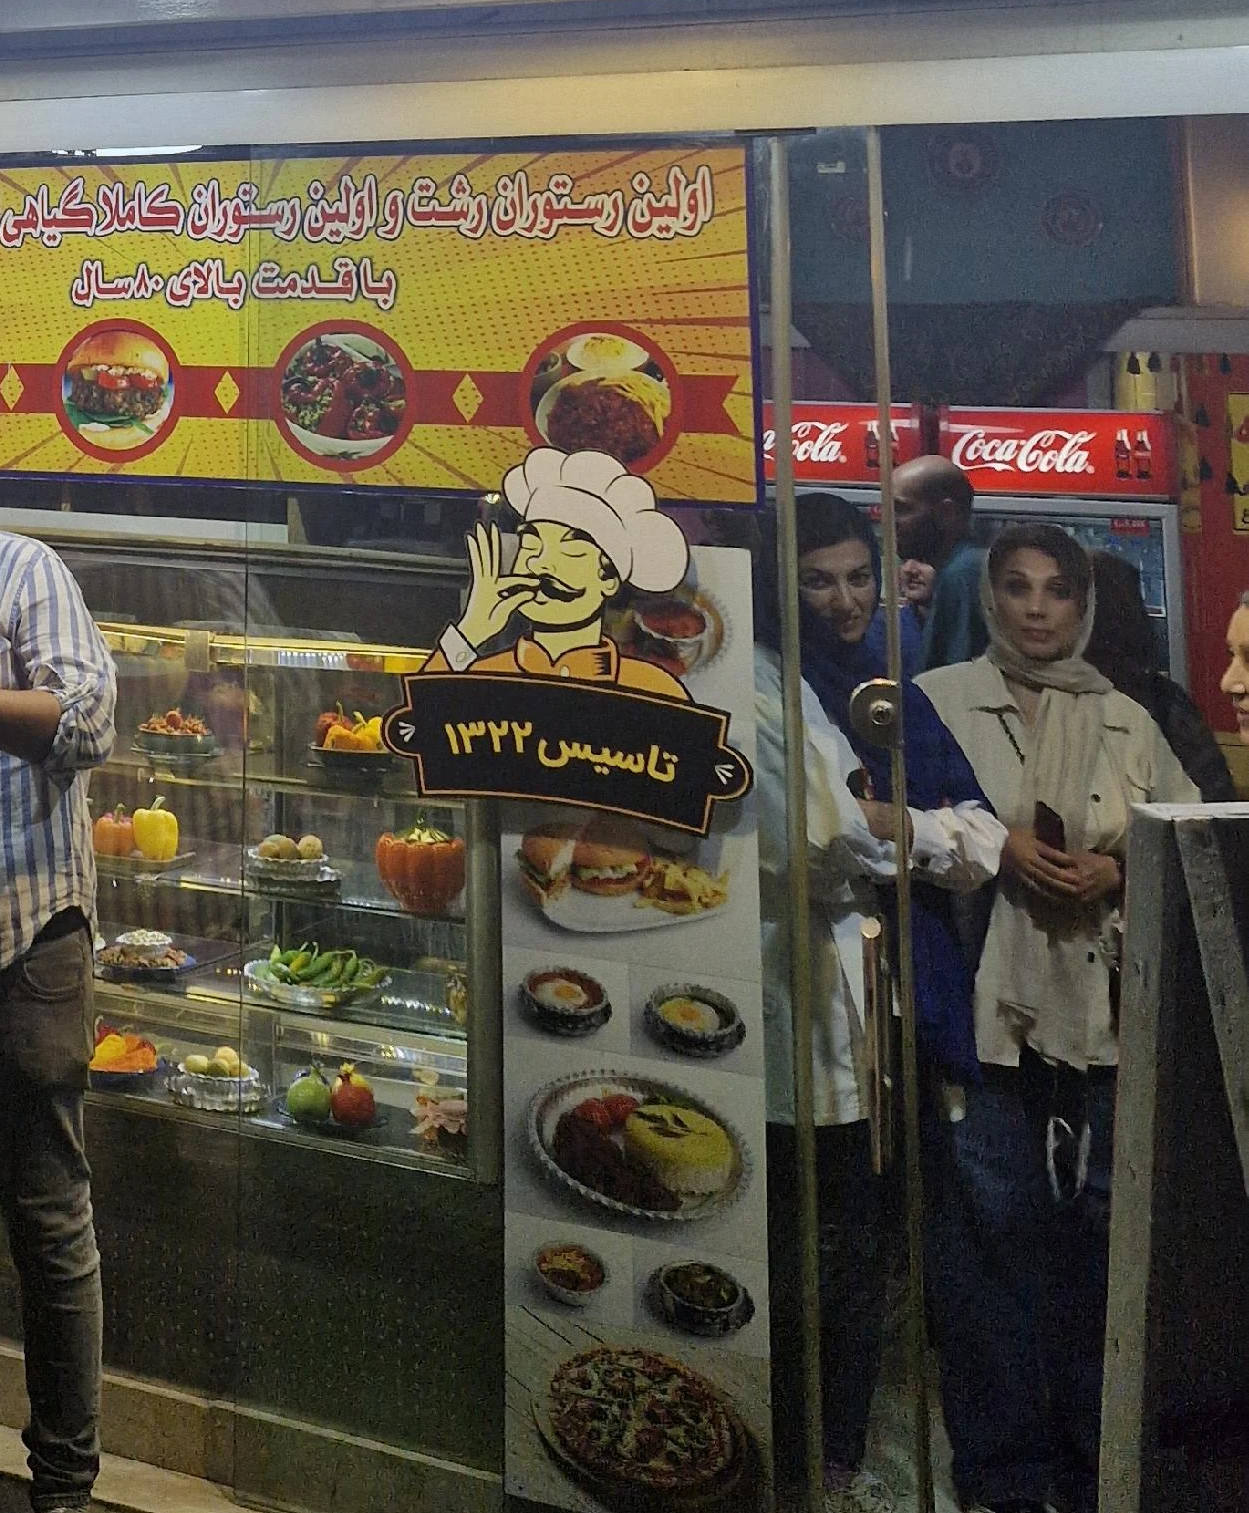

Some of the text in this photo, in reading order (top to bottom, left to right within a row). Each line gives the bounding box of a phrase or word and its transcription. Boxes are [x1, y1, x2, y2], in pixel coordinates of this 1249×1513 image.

[0, 176, 97, 247] گیاهی
[97, 181, 185, 237] کاملا
[187, 178, 300, 244] رستوران
[303, 175, 378, 243] اولین
[376, 190, 403, 238] و
[407, 174, 488, 238] رشت
[491, 170, 623, 238] رستوران
[627, 165, 713, 239] اولین
[166, 259, 245, 310] بالای
[252, 257, 358, 301] قدمت
[360, 257, 397, 310] با
[952, 429, 1097, 475] Coca-Cola
[444, 720, 679, 782] تاسیس ۱۳۲۲
